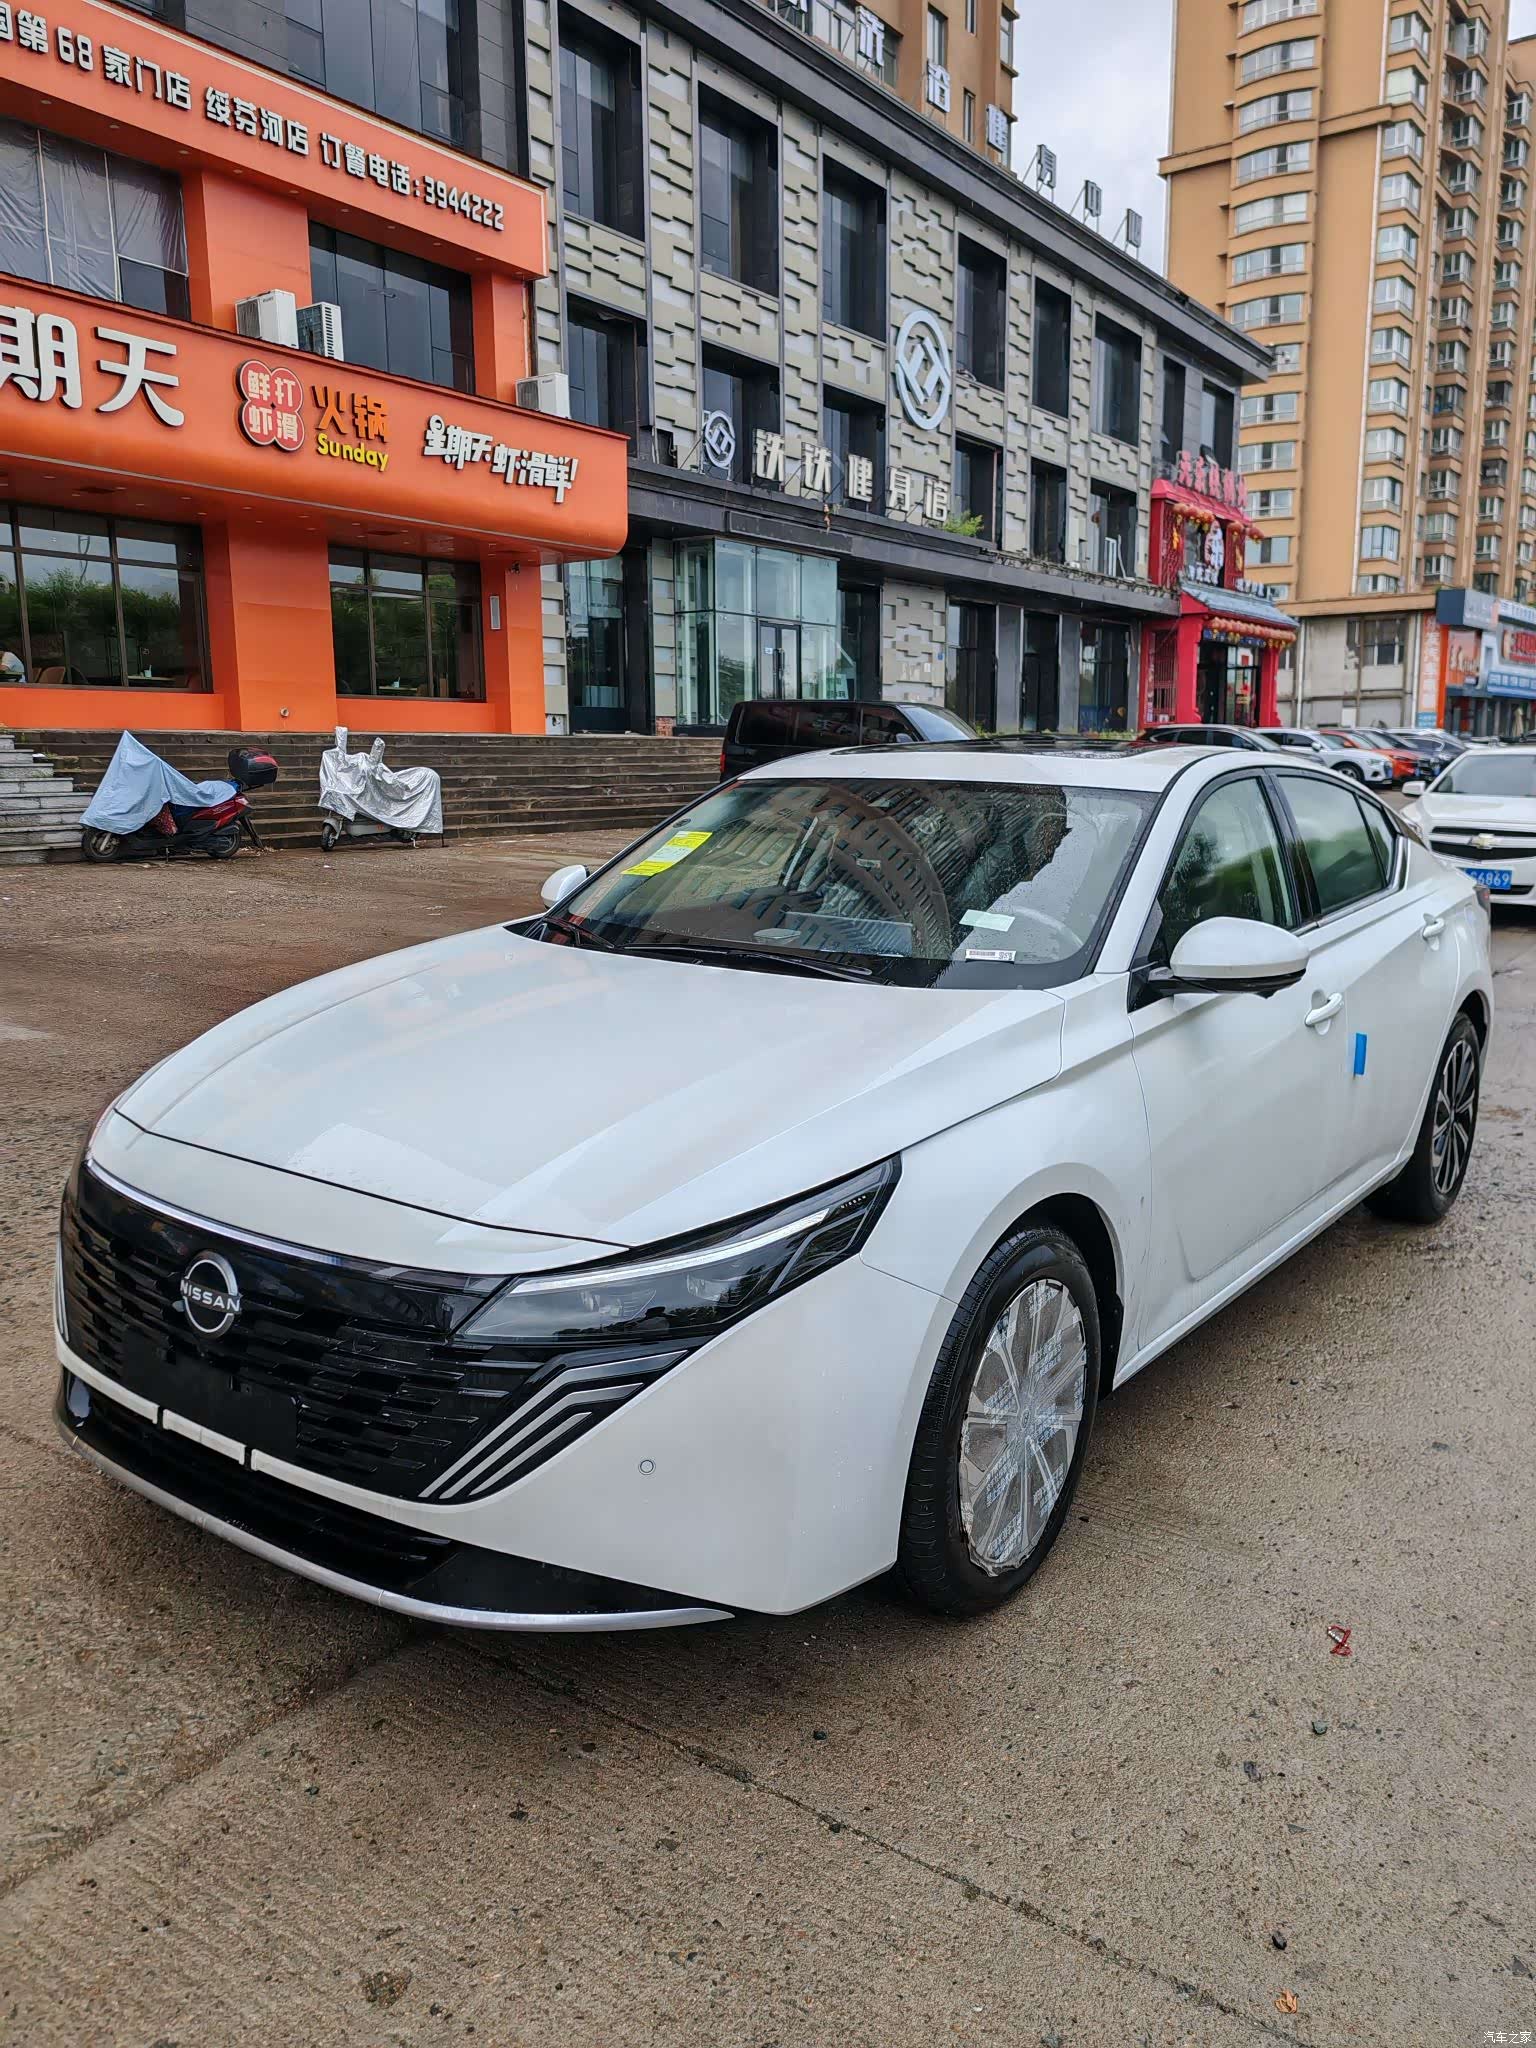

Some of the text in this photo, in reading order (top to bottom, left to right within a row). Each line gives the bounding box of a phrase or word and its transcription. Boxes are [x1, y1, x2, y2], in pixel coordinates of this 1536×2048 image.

[206, 86, 309, 156] 绥芬河店
[320, 132, 505, 231] 订餐电话:3944222
[0, 305, 185, 427] 期天
[312, 385, 391, 443] 火锅
[317, 432, 389, 472] Sunday
[180, 1279, 240, 1312] NISSAN
